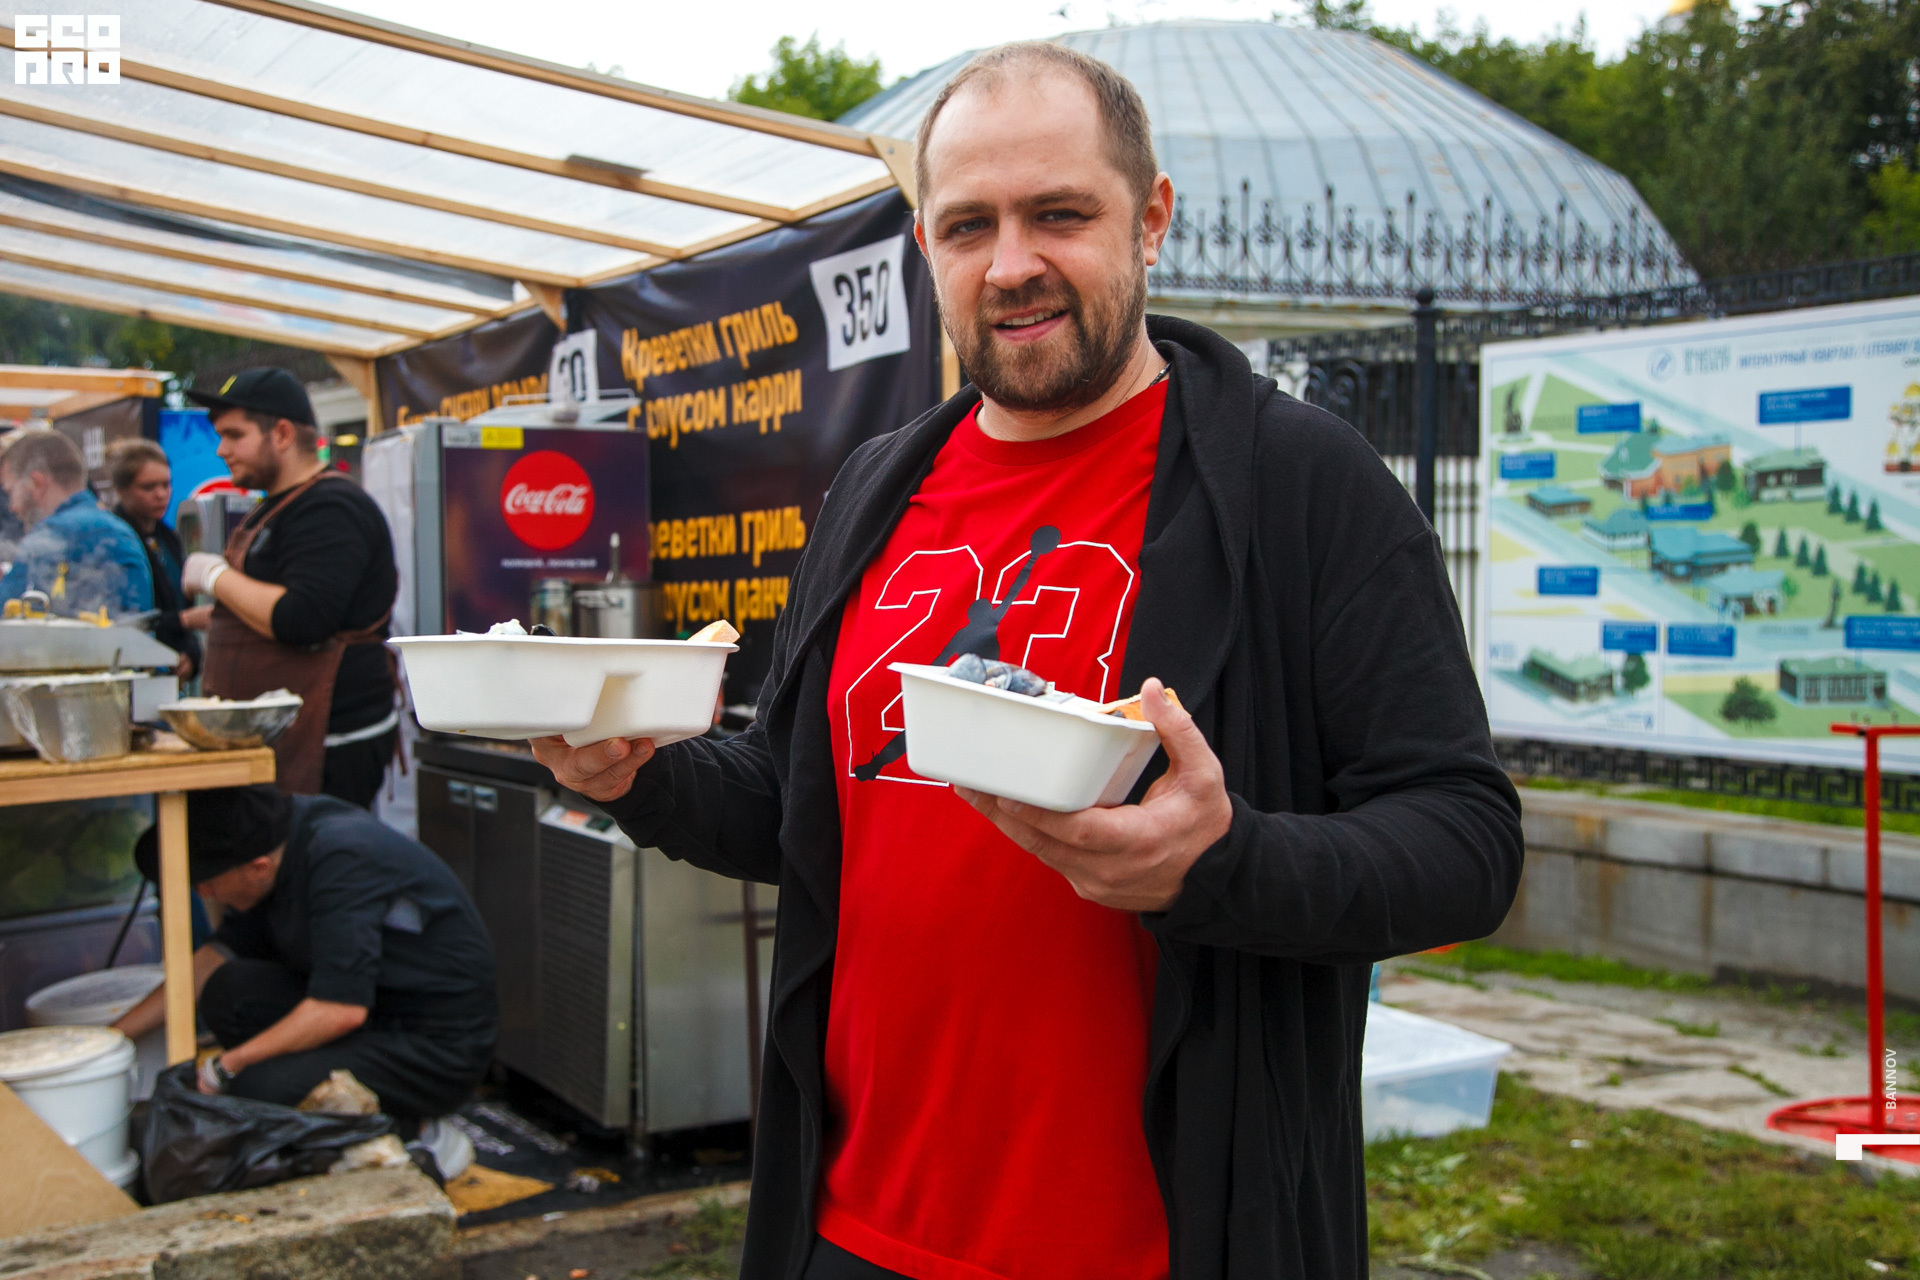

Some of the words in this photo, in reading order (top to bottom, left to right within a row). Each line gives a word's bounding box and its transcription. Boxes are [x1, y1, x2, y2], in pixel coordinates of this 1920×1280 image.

[833, 259, 889, 346] 350
[621, 321, 722, 393] Креветки
[718, 300, 799, 371] гриль
[731, 368, 802, 435] карри
[504, 482, 591, 515] Coca-Cola
[741, 505, 807, 568] гриль
[847, 540, 1134, 786] 23
